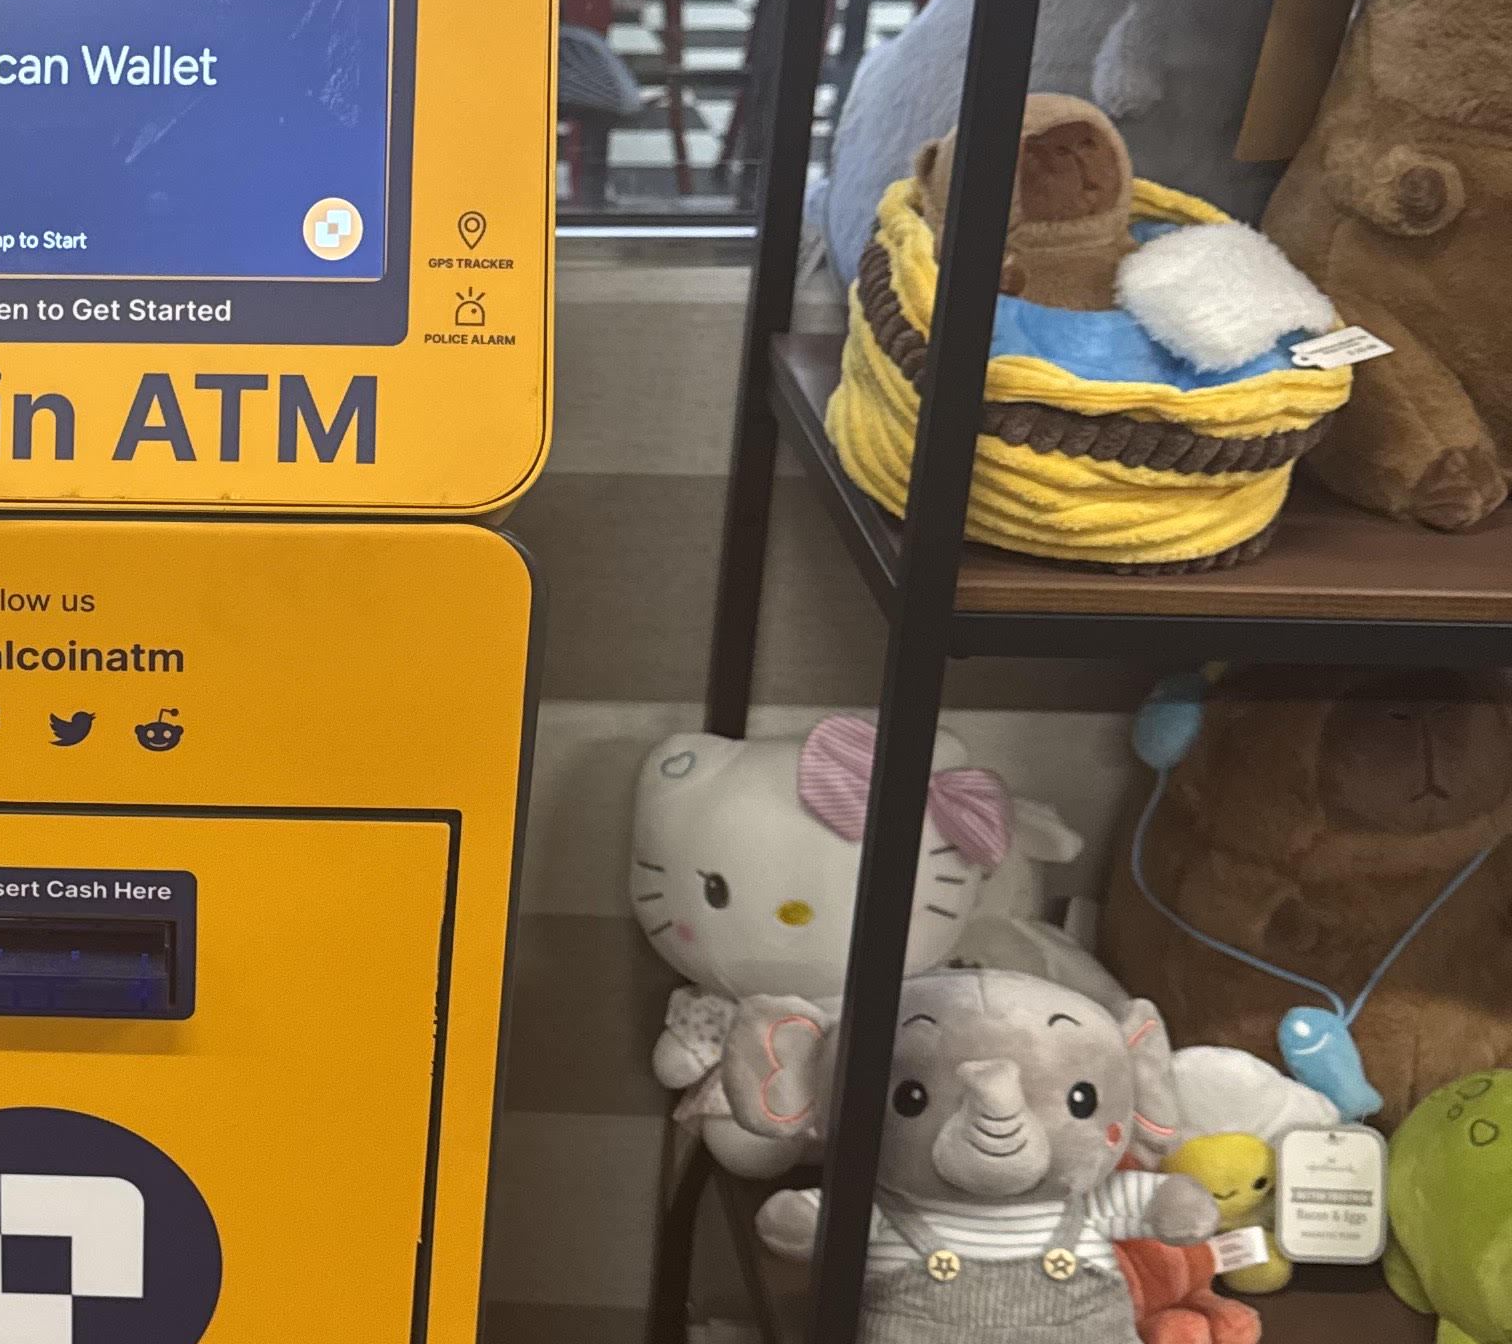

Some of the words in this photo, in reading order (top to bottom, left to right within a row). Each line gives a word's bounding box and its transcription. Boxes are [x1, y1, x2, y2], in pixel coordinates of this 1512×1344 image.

[82, 45, 218, 86] Wallet
[19, 232, 38, 249] to
[42, 230, 88, 249] Start
[428, 258, 454, 269] GPS
[456, 258, 514, 269] TRACKER
[37, 300, 64, 322] to
[71, 299, 121, 323] Get
[129, 299, 232, 323] Started
[424, 334, 468, 345] POLICE
[471, 335, 516, 346] ALARM
[112, 373, 378, 465] ATM
[62, 594, 95, 613] us
[47, 880, 107, 899] Cash
[114, 882, 172, 901] Here
